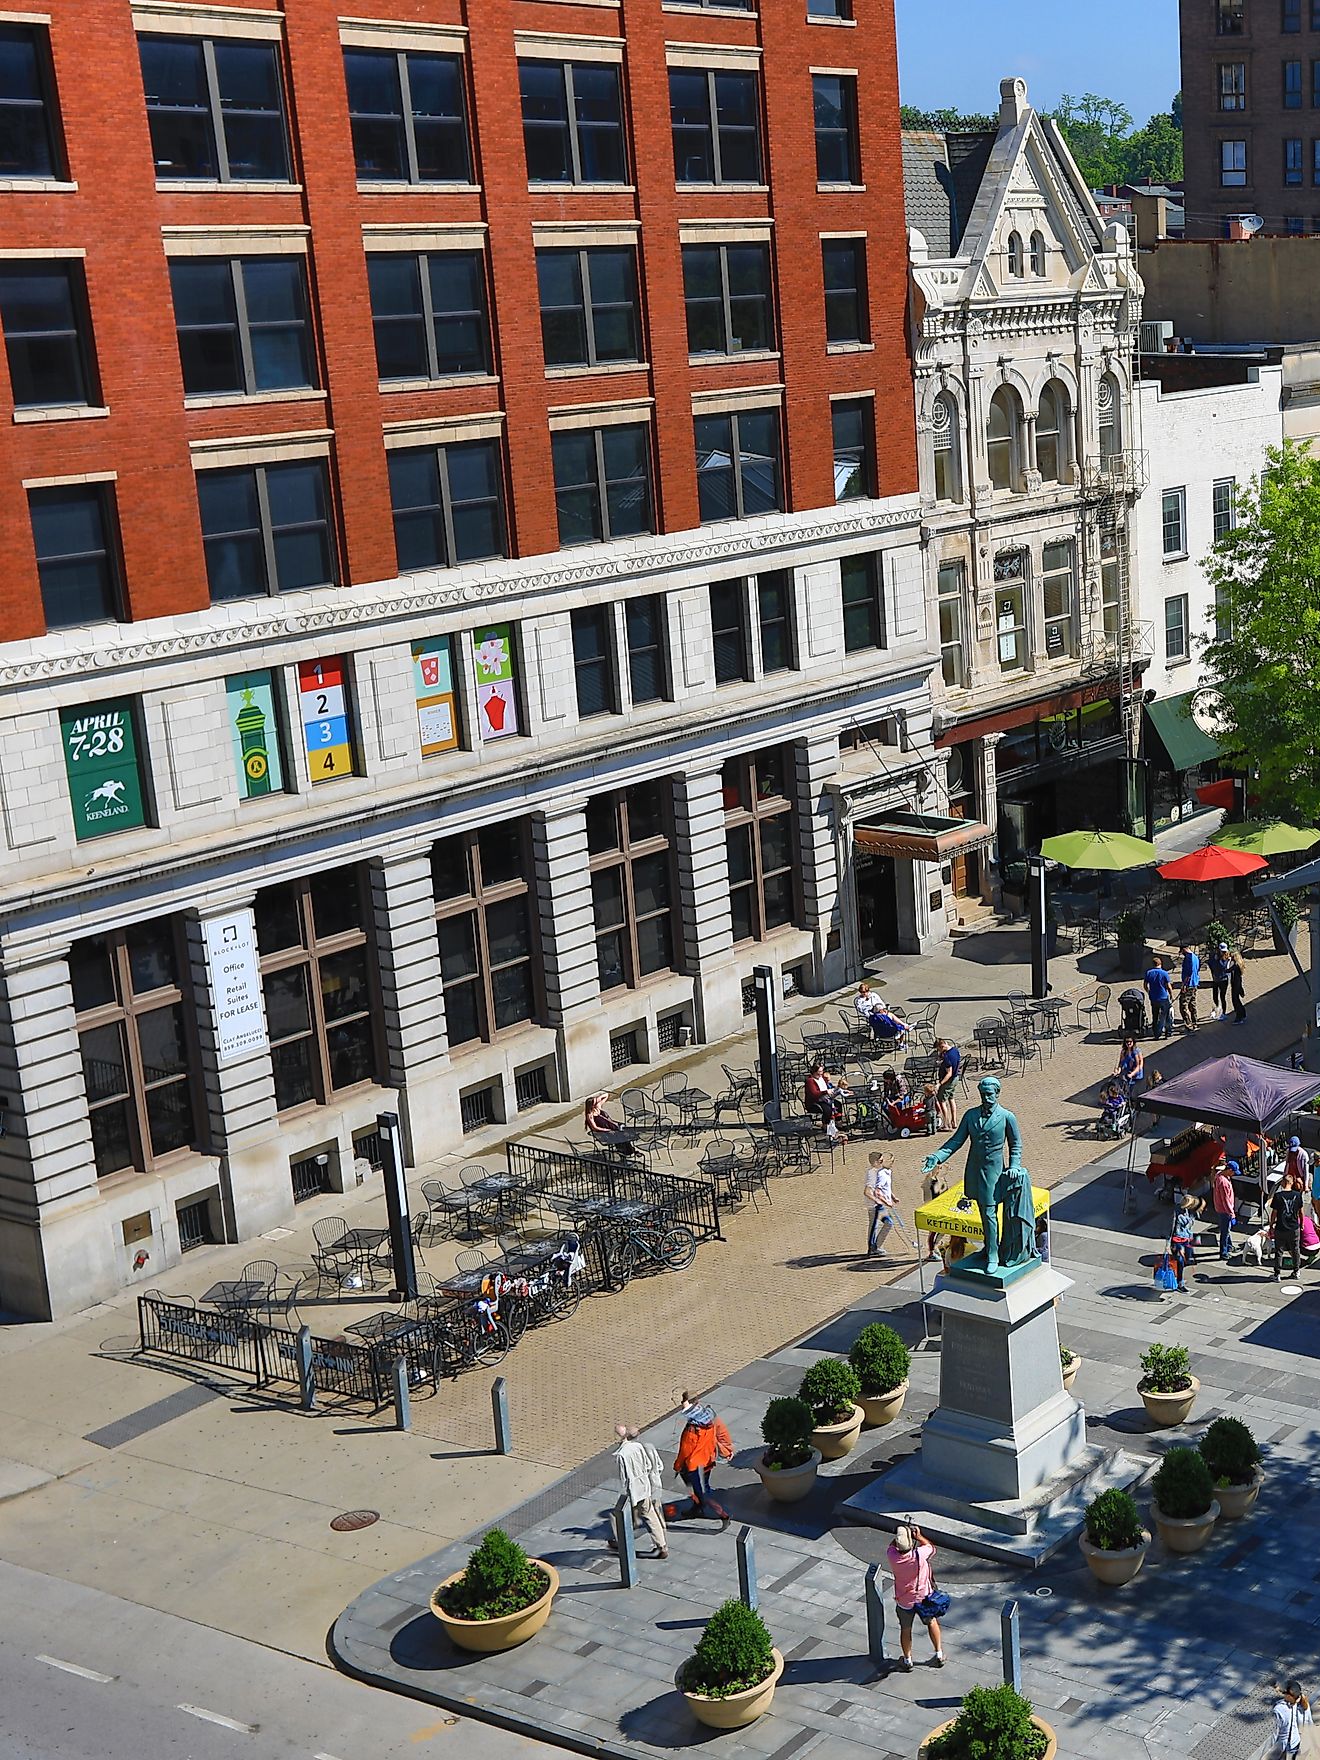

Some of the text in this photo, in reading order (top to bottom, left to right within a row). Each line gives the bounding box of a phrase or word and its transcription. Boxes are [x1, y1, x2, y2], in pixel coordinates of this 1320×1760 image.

[313, 664, 325, 684] 1
[316, 694, 329, 715] 2
[70, 711, 125, 735] APRIL
[319, 722, 333, 743] 3
[69, 727, 124, 761] 7-28
[323, 752, 335, 771] 4
[86, 804, 129, 822] KEENELAND
[223, 962, 245, 974] Office
[226, 982, 247, 994] Retail
[227, 994, 249, 1006] Suites
[220, 1001, 259, 1020] FOR LEASE
[927, 1218, 959, 1232] KETTLE
[160, 1316, 239, 1348] STAGGER INN
[336, 1356, 355, 1375] INN
